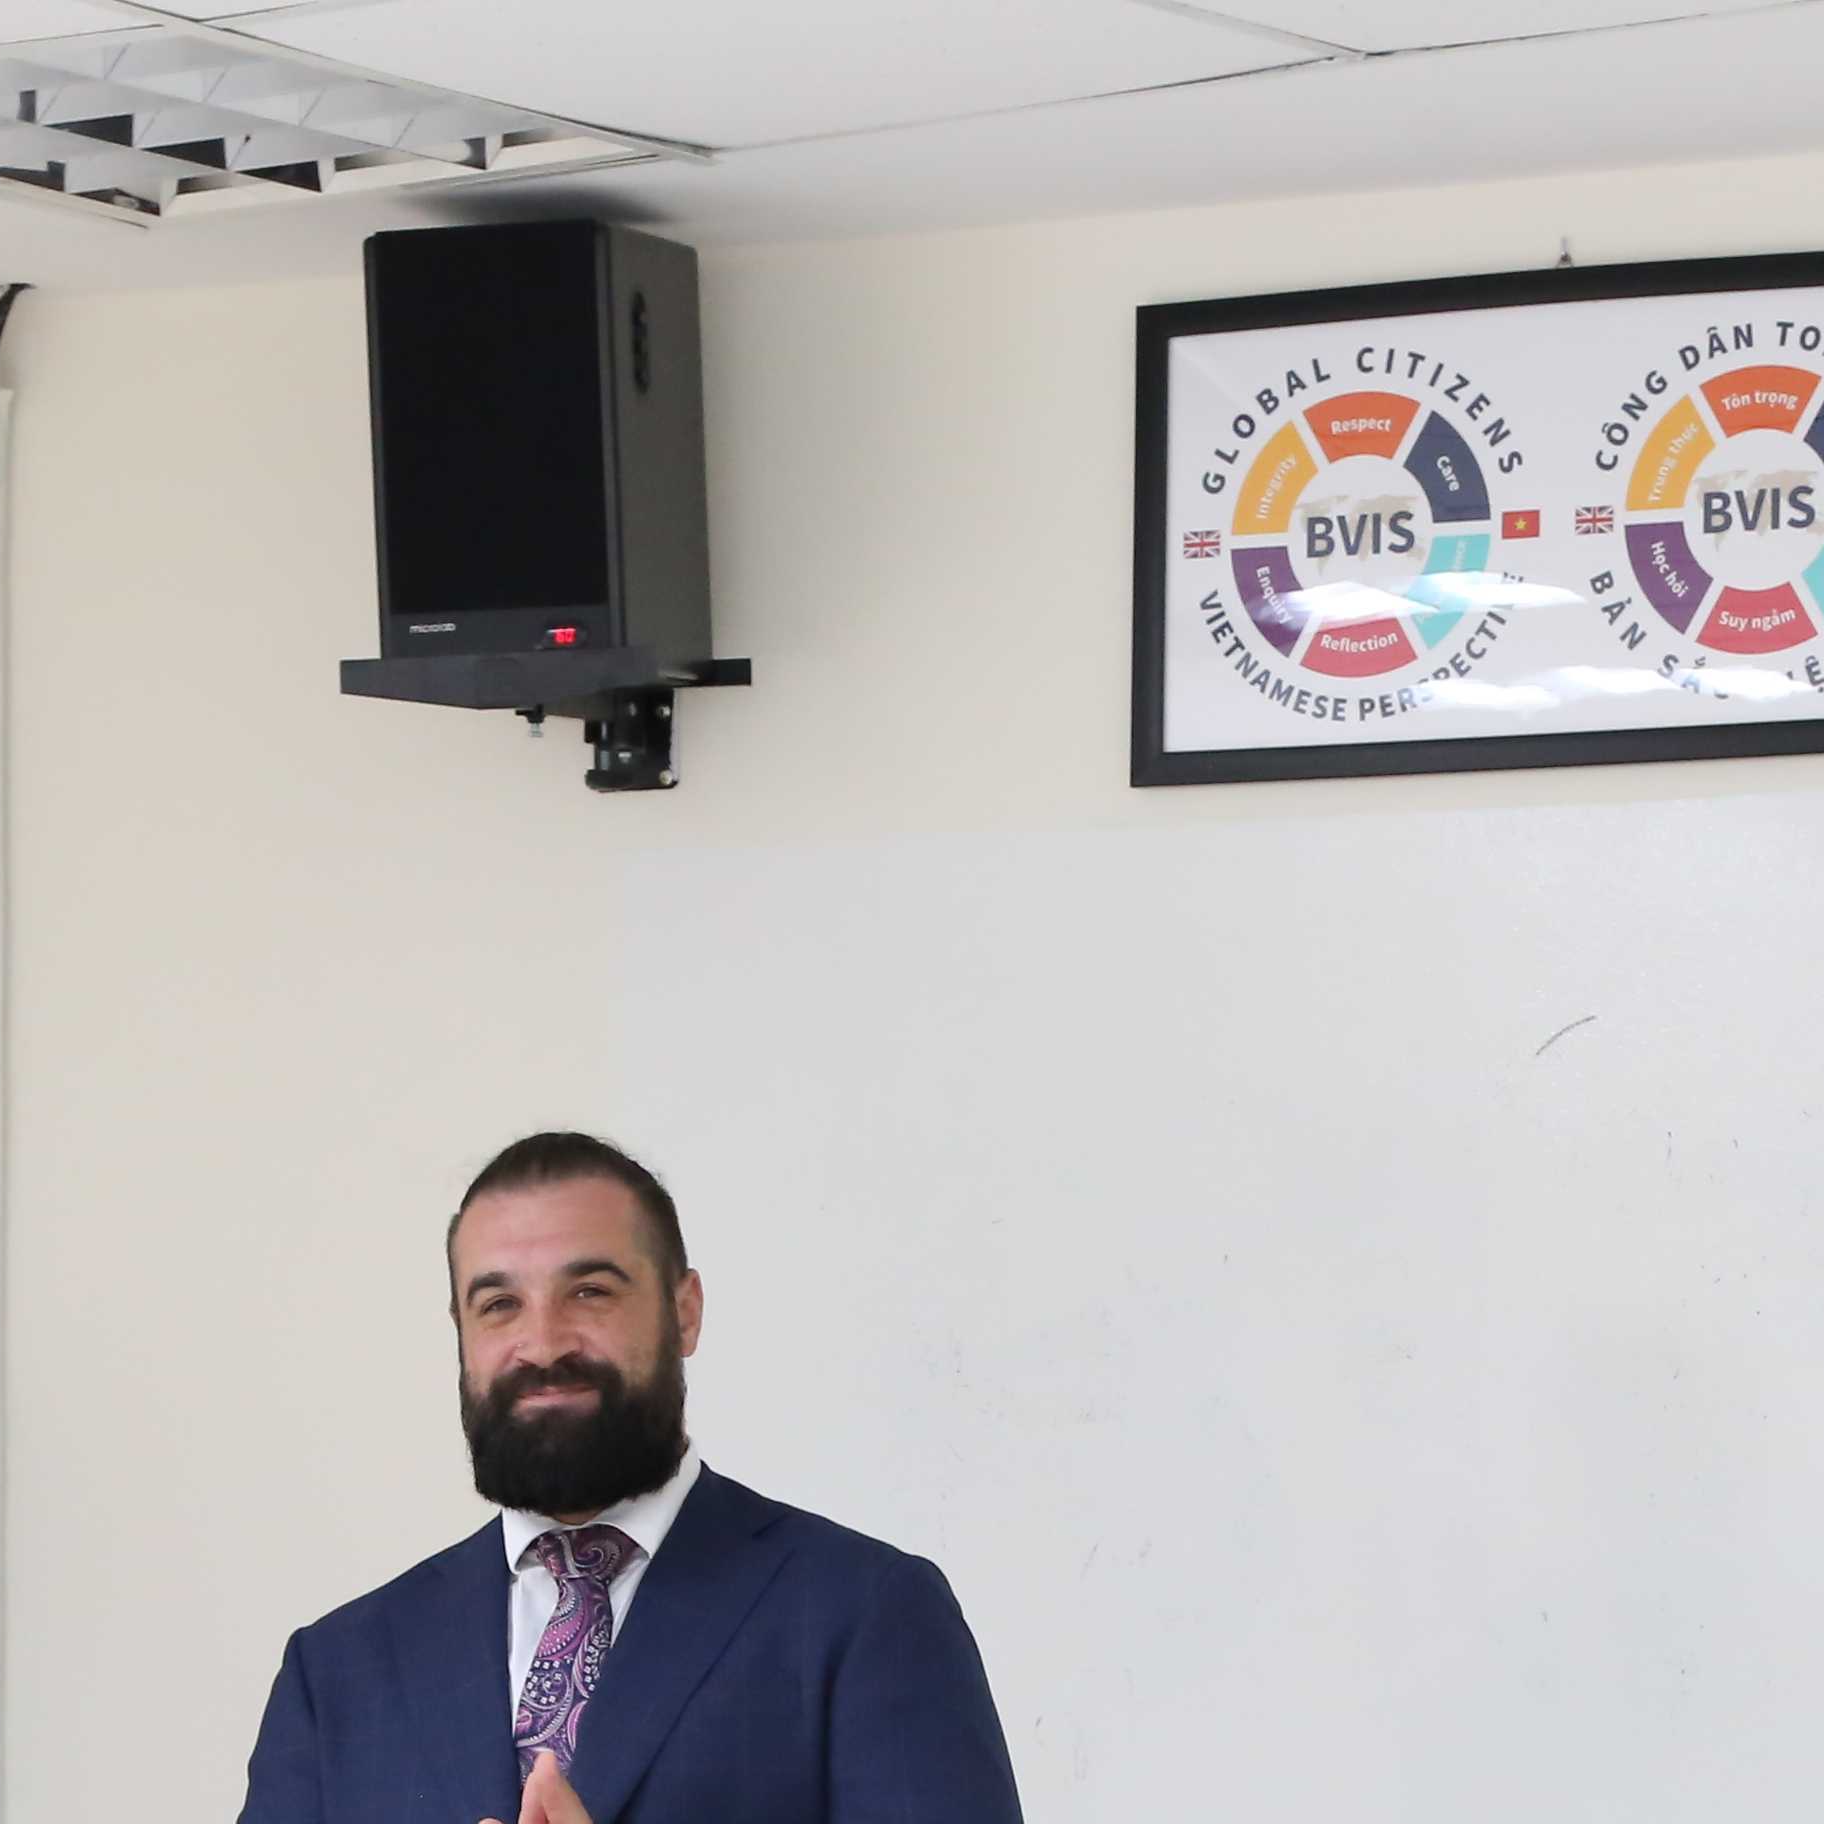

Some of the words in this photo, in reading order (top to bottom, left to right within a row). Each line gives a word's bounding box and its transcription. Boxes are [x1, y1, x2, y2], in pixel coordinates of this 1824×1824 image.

[1202, 358, 1331, 495] GLOBAL
[1356, 347, 1524, 474] CITIZENS
[1595, 370, 1668, 472] CÔNG
[1678, 322, 1754, 371] DÂN
[1330, 416, 1393, 436] Respect
[1256, 453, 1298, 520] Integrity
[1436, 454, 1461, 493] Care
[1648, 457, 1677, 502] Trung
[1306, 510, 1415, 559] BVIS
[1703, 486, 1816, 535] BVIS
[1256, 566, 1294, 624] Enquiry
[1320, 630, 1398, 652] Reflection
[1719, 610, 1748, 632] Suy
[1199, 589, 1347, 722] VIETNAMESE
